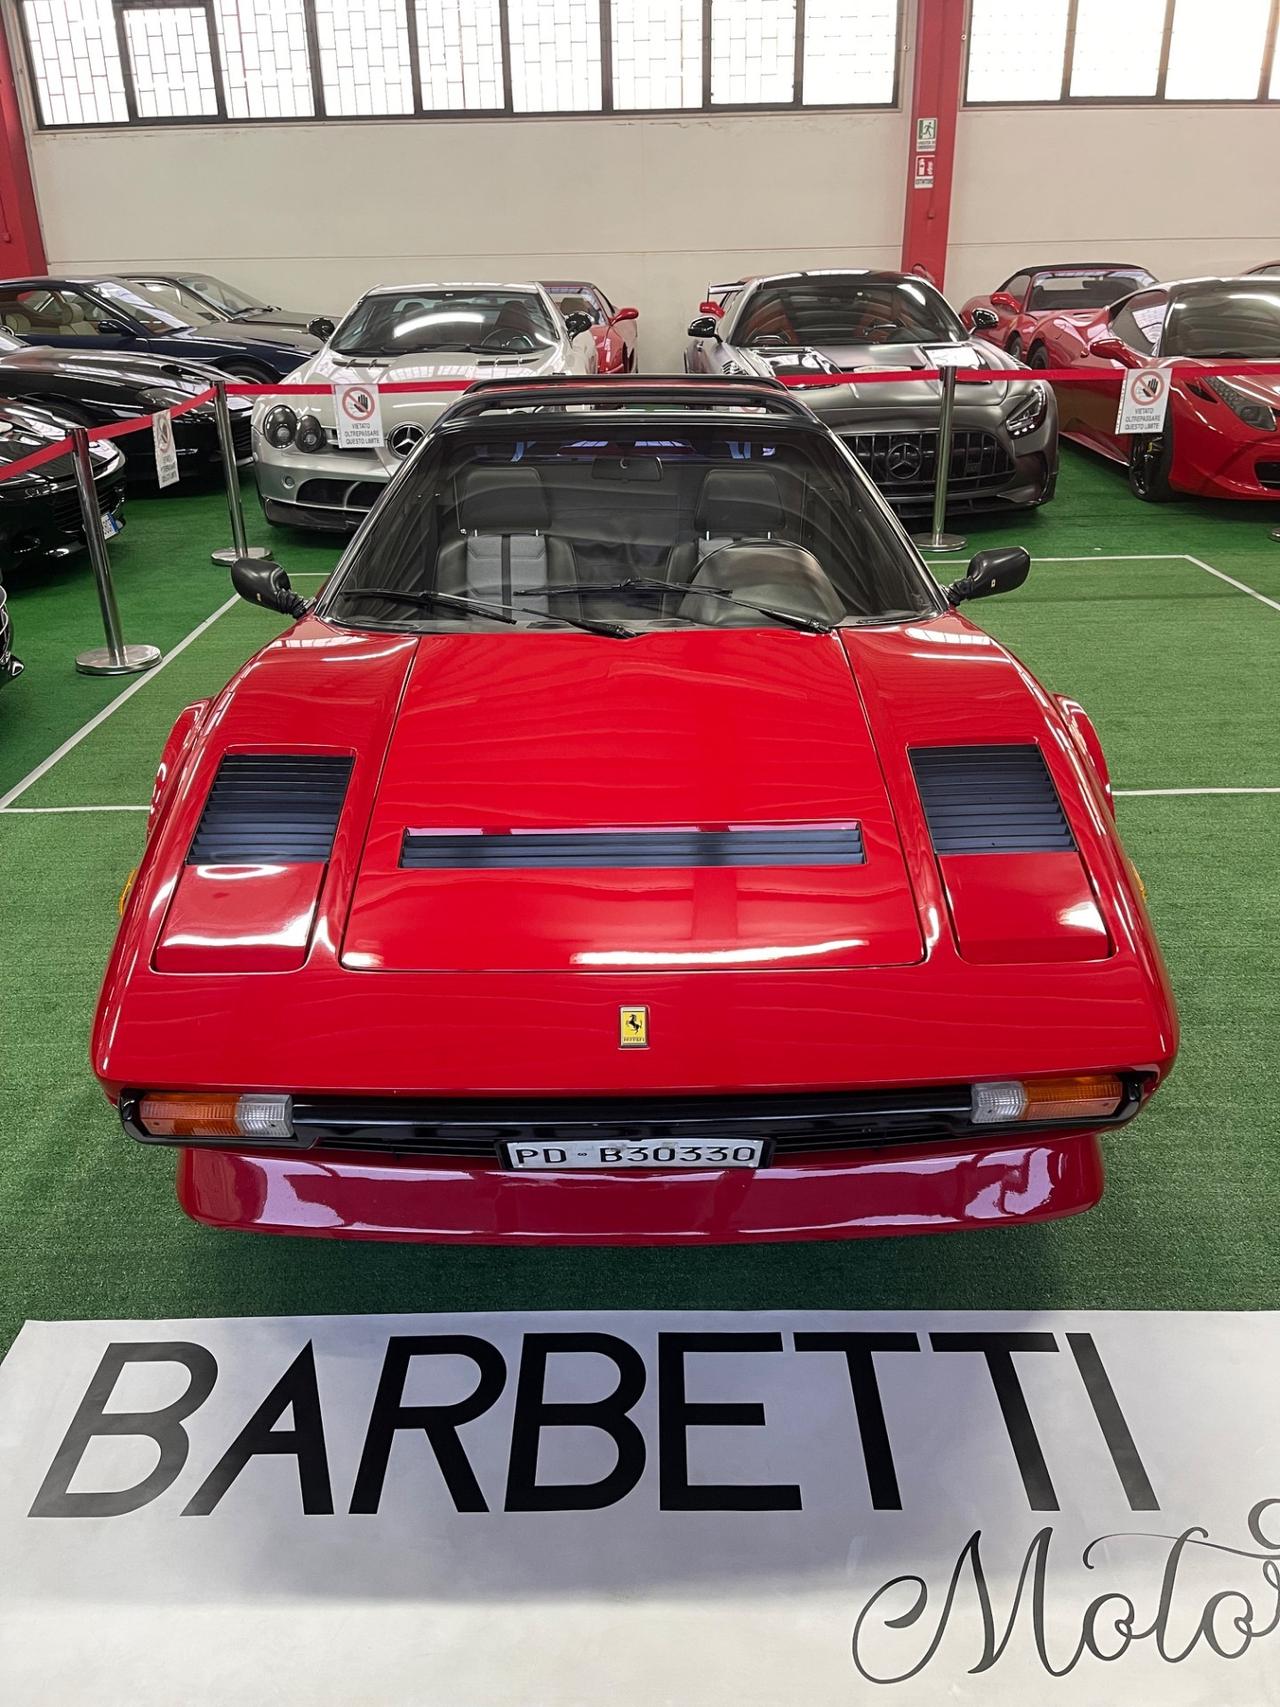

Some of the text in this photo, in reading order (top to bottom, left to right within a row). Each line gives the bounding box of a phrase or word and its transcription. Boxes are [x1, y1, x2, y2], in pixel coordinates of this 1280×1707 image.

[1135, 407, 1154, 415] VIETATO
[344, 430, 380, 438] OLTREPASSARE
[515, 1146, 756, 1164] PD B30330
[27, 1331, 1161, 1518] BARBETTI
